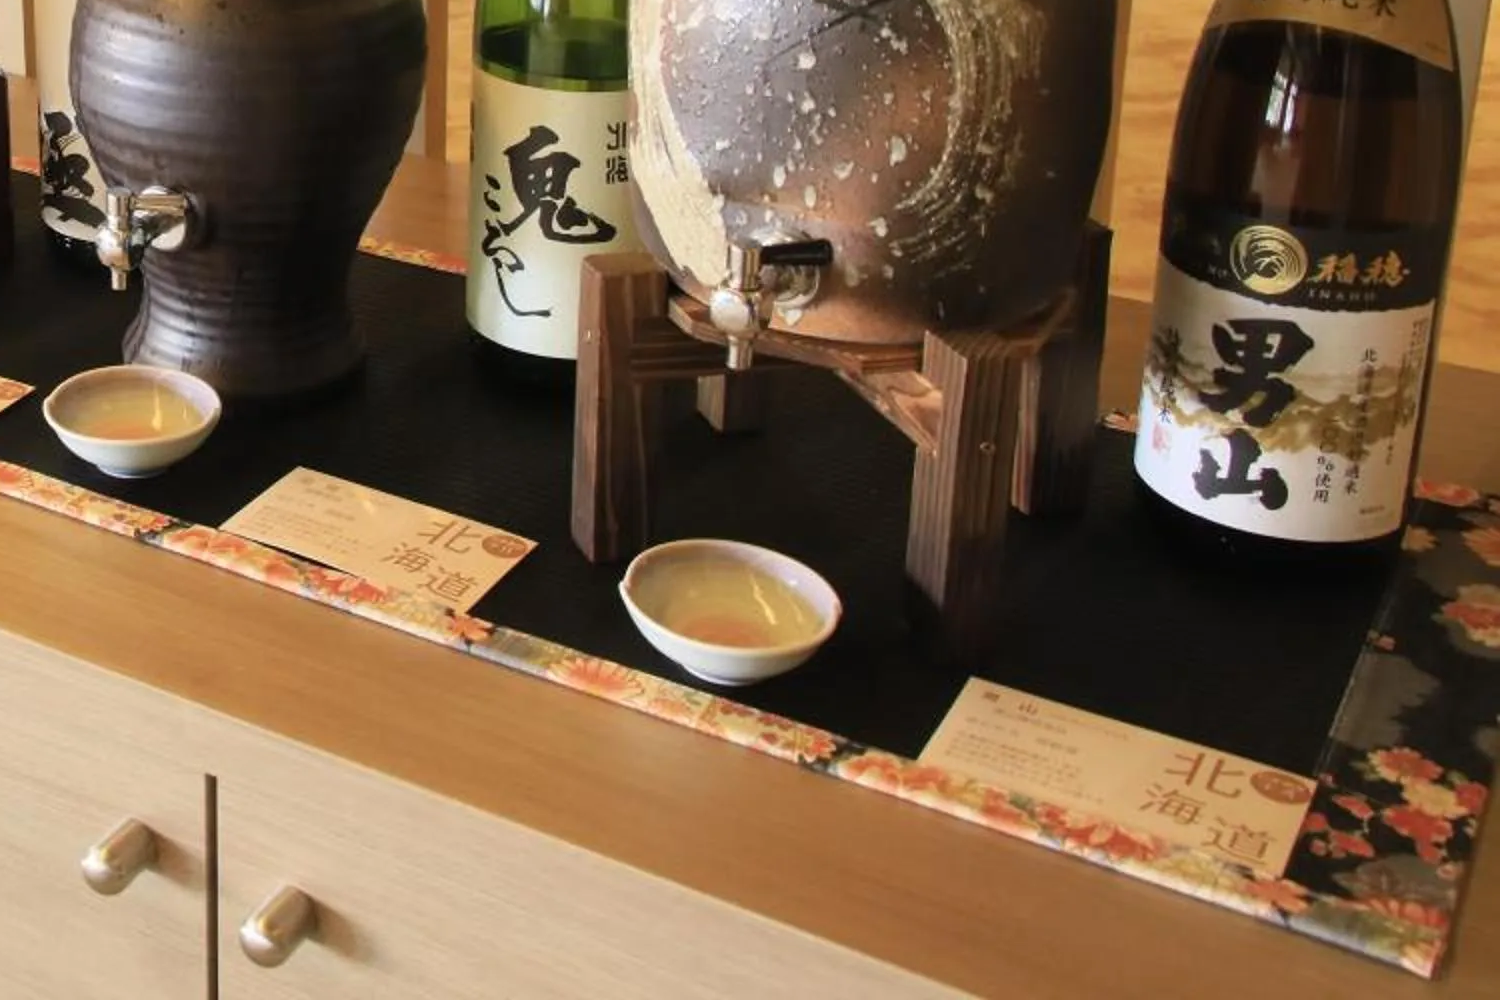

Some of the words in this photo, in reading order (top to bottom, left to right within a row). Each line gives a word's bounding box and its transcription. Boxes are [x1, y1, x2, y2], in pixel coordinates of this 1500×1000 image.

[1192, 319, 1316, 511] 男山
[381, 519, 482, 602] 北海道
[1139, 751, 1279, 865] 北海道
